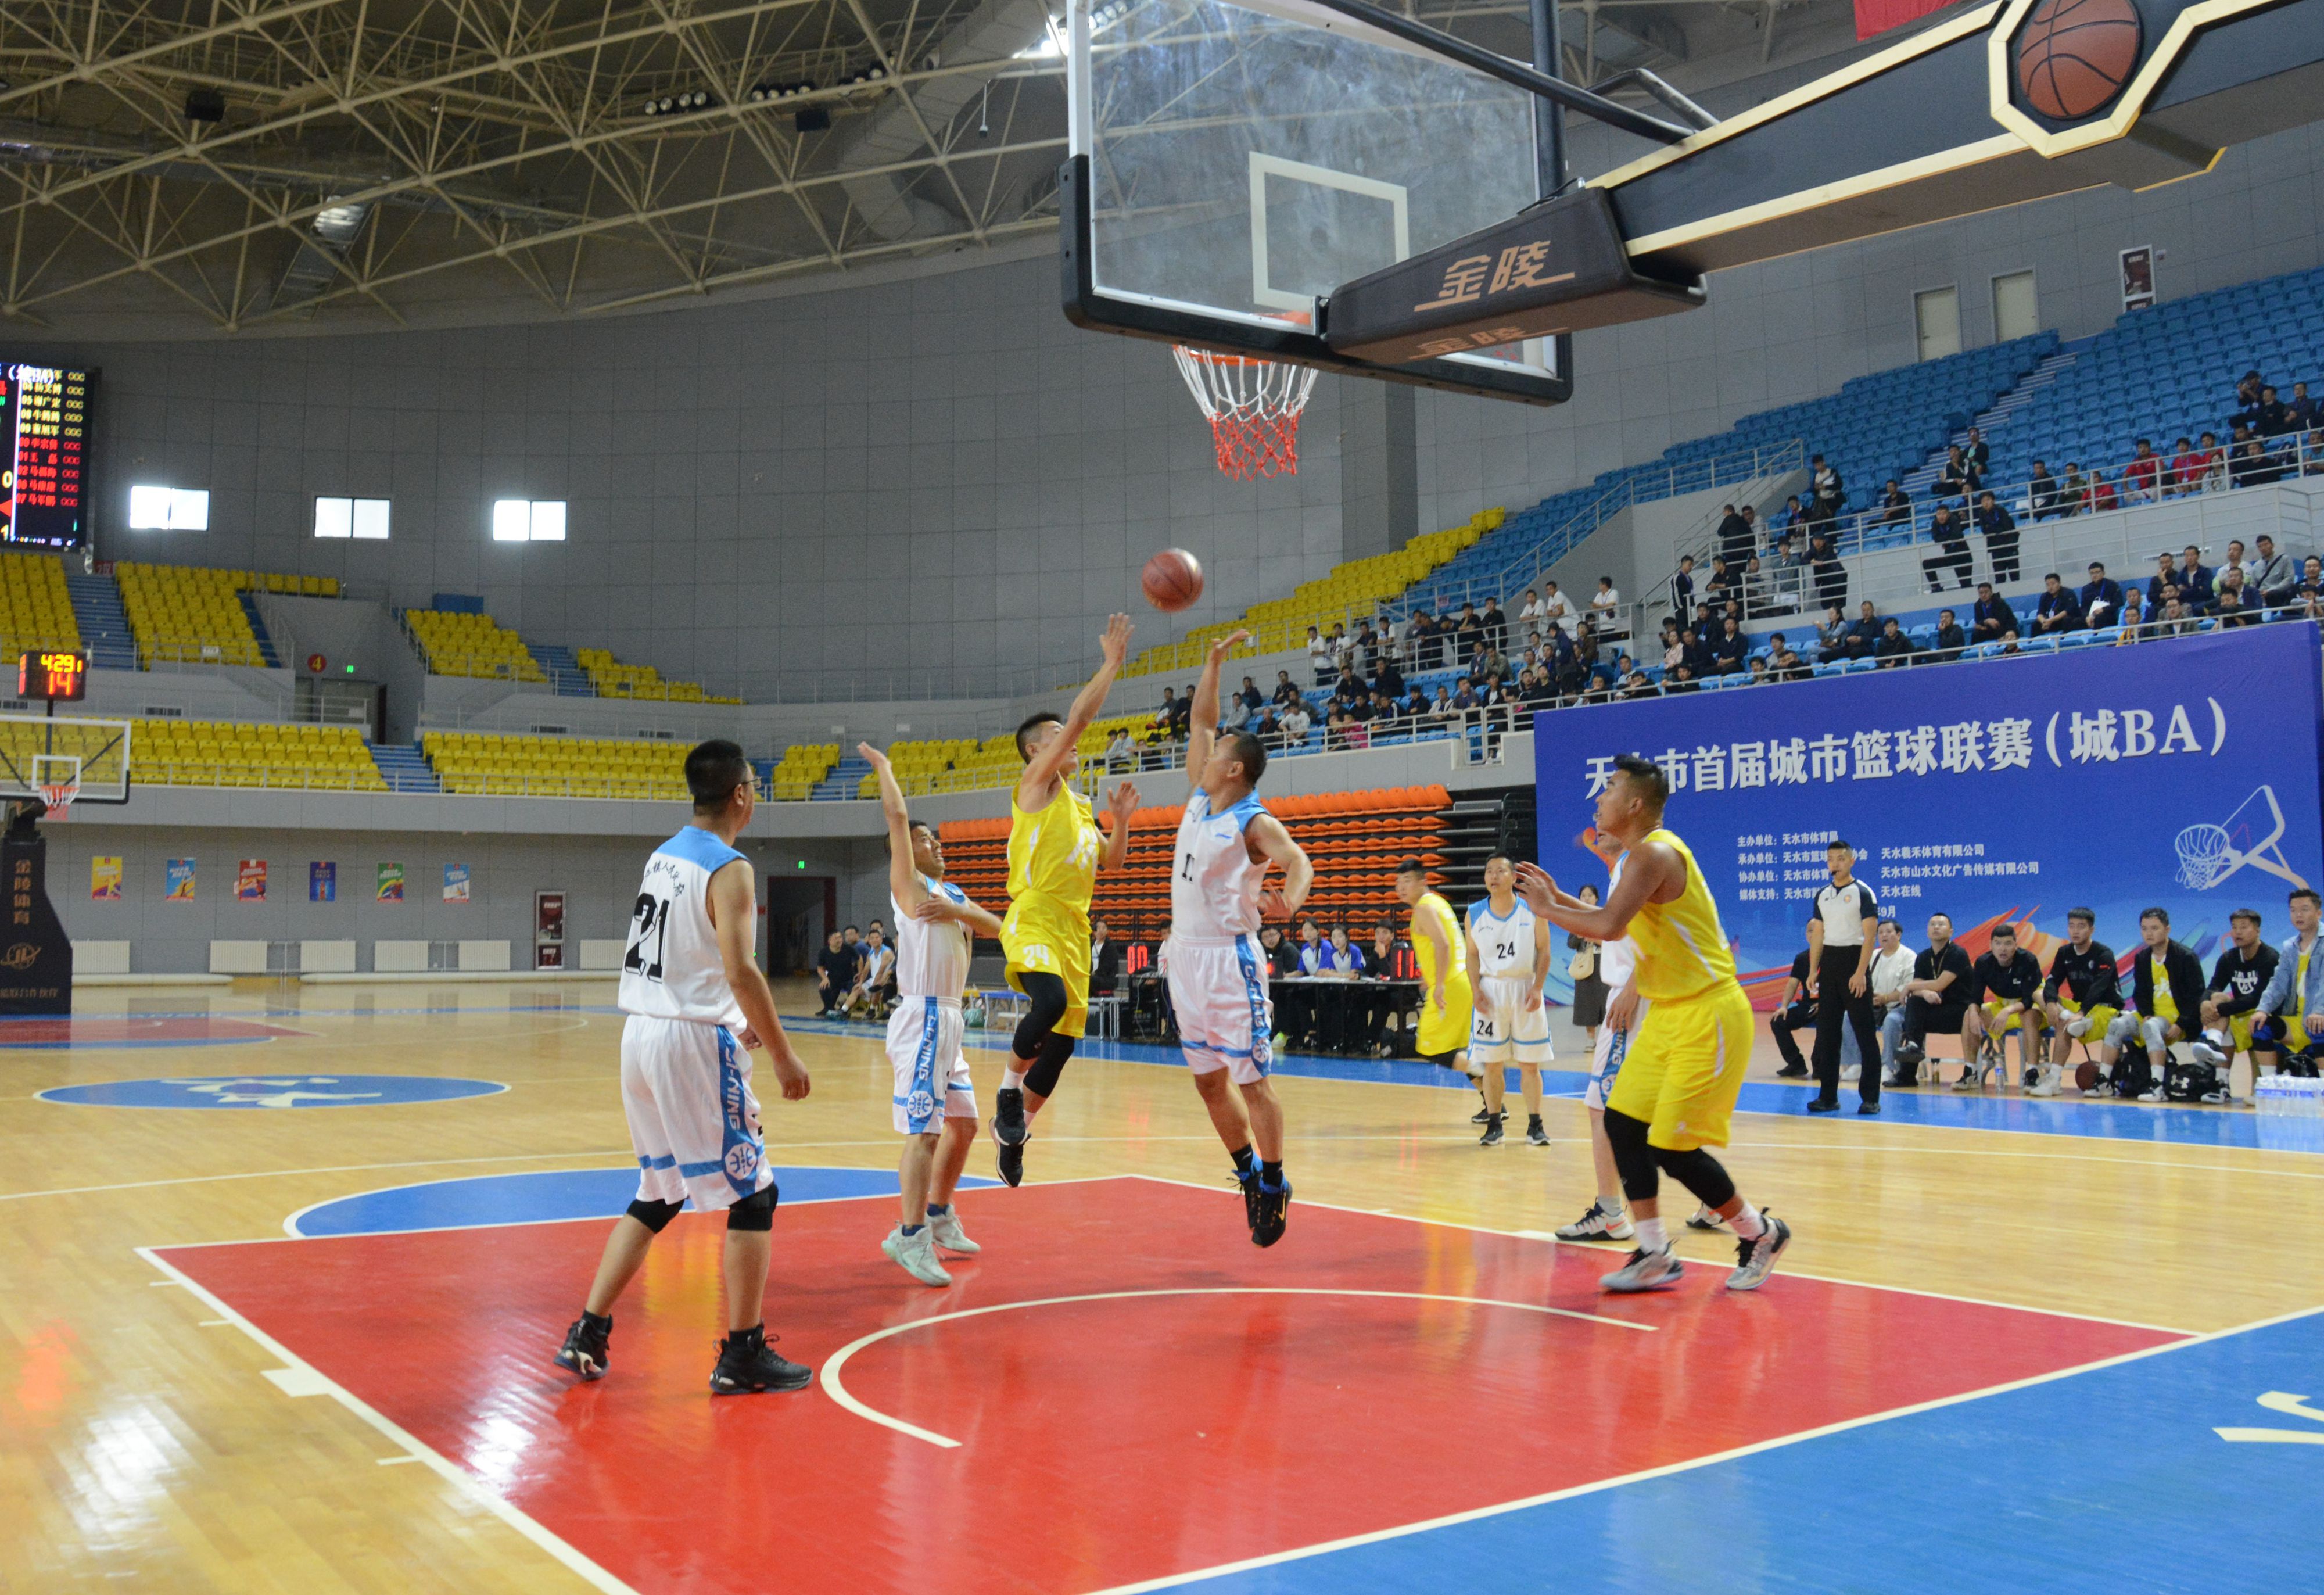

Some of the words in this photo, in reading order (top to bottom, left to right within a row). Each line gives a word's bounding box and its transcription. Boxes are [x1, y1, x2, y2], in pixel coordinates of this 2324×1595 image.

[1414, 240, 1576, 313] 金陵
[48, 671, 74, 696] 14
[1881, 884, 1922, 898] 天水在线
[625, 893, 669, 984] 21
[1496, 941, 1515, 959] 24
[1023, 944, 1050, 969] 24
[1476, 1019, 1494, 1037] 24
[917, 1014, 937, 1082] LI-NING
